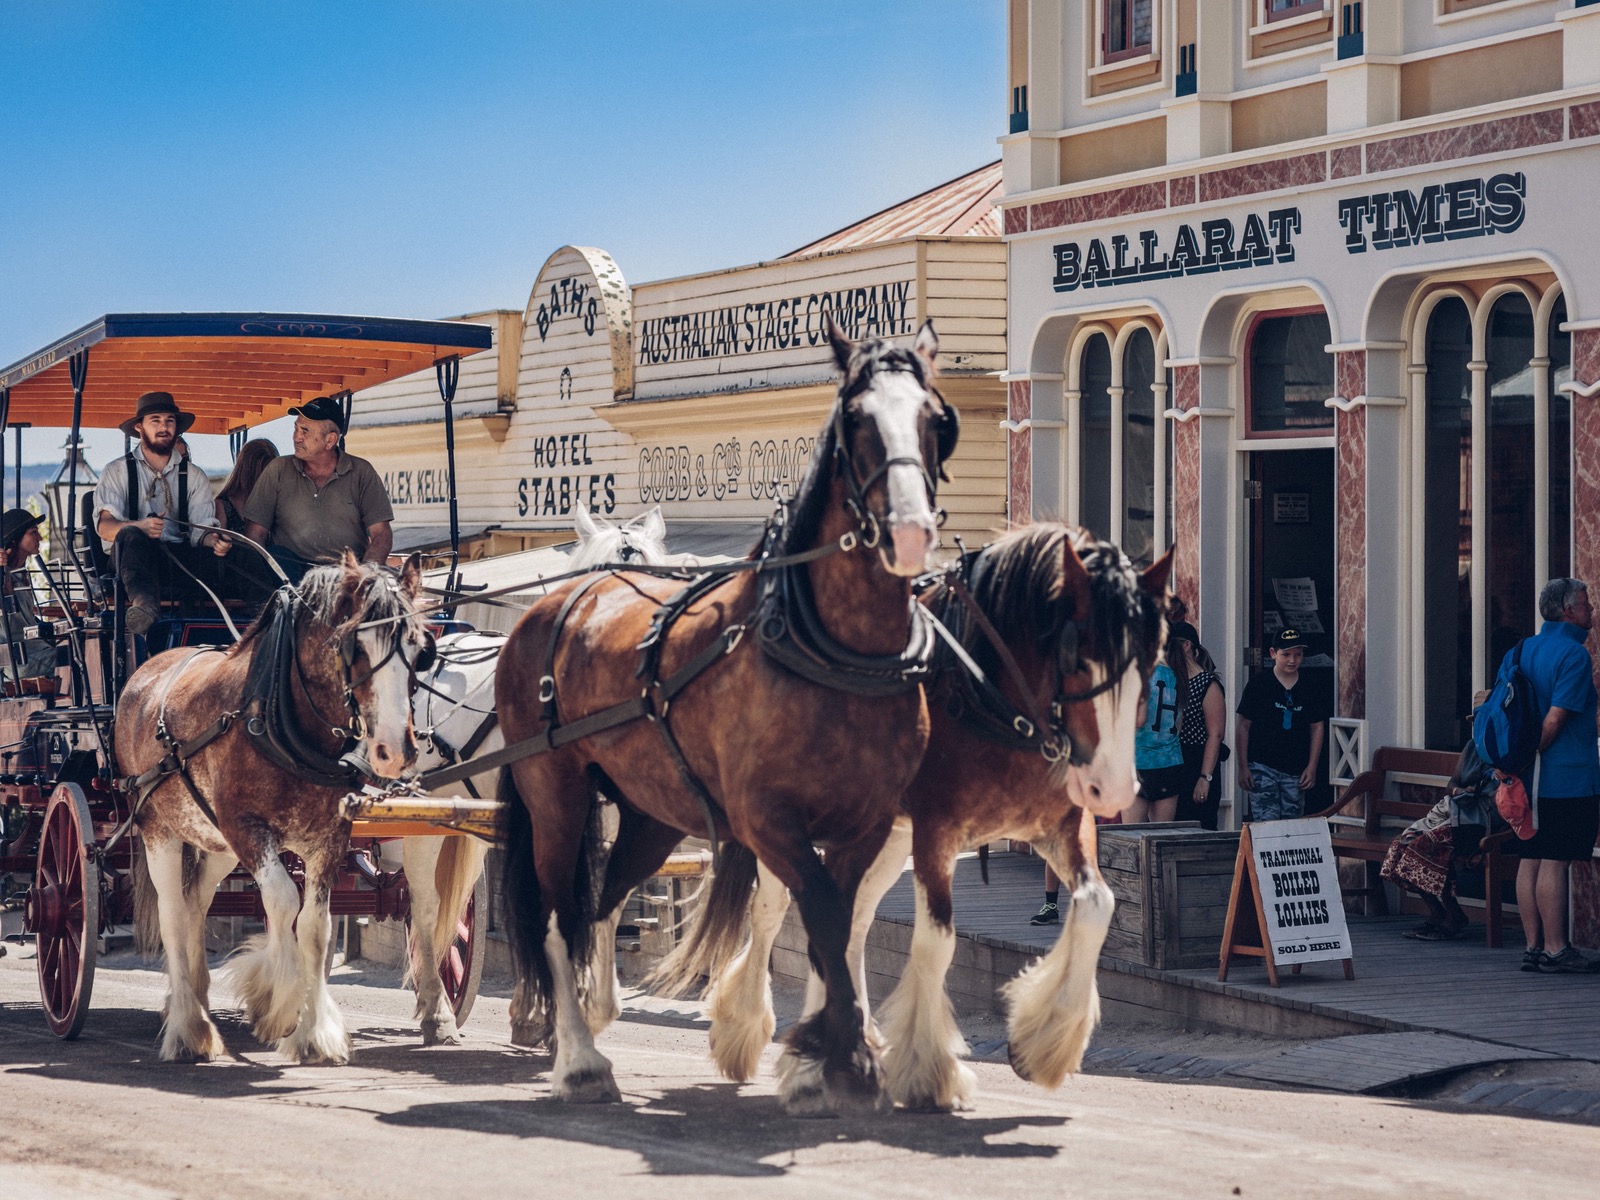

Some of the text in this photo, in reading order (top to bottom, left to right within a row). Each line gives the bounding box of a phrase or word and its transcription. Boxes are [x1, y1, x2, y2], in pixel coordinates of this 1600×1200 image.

[1053, 172, 1526, 293] BALLARAT TIMES
[536, 278, 598, 343] BATH'S
[640, 281, 911, 364] AUSTRALIAN STAGE COMPANY.
[534, 434, 592, 468] HOTEL
[384, 469, 450, 504] ALEX KELLY
[639, 446, 691, 504] COBB
[696, 454, 708, 497] &
[748, 437, 814, 500] COAC
[1260, 848, 1323, 868] TRADITIONAL
[1272, 870, 1320, 897] BOILED
[1275, 899, 1329, 928] LOLLIES
[1278, 941, 1341, 955] SOLD HERE
